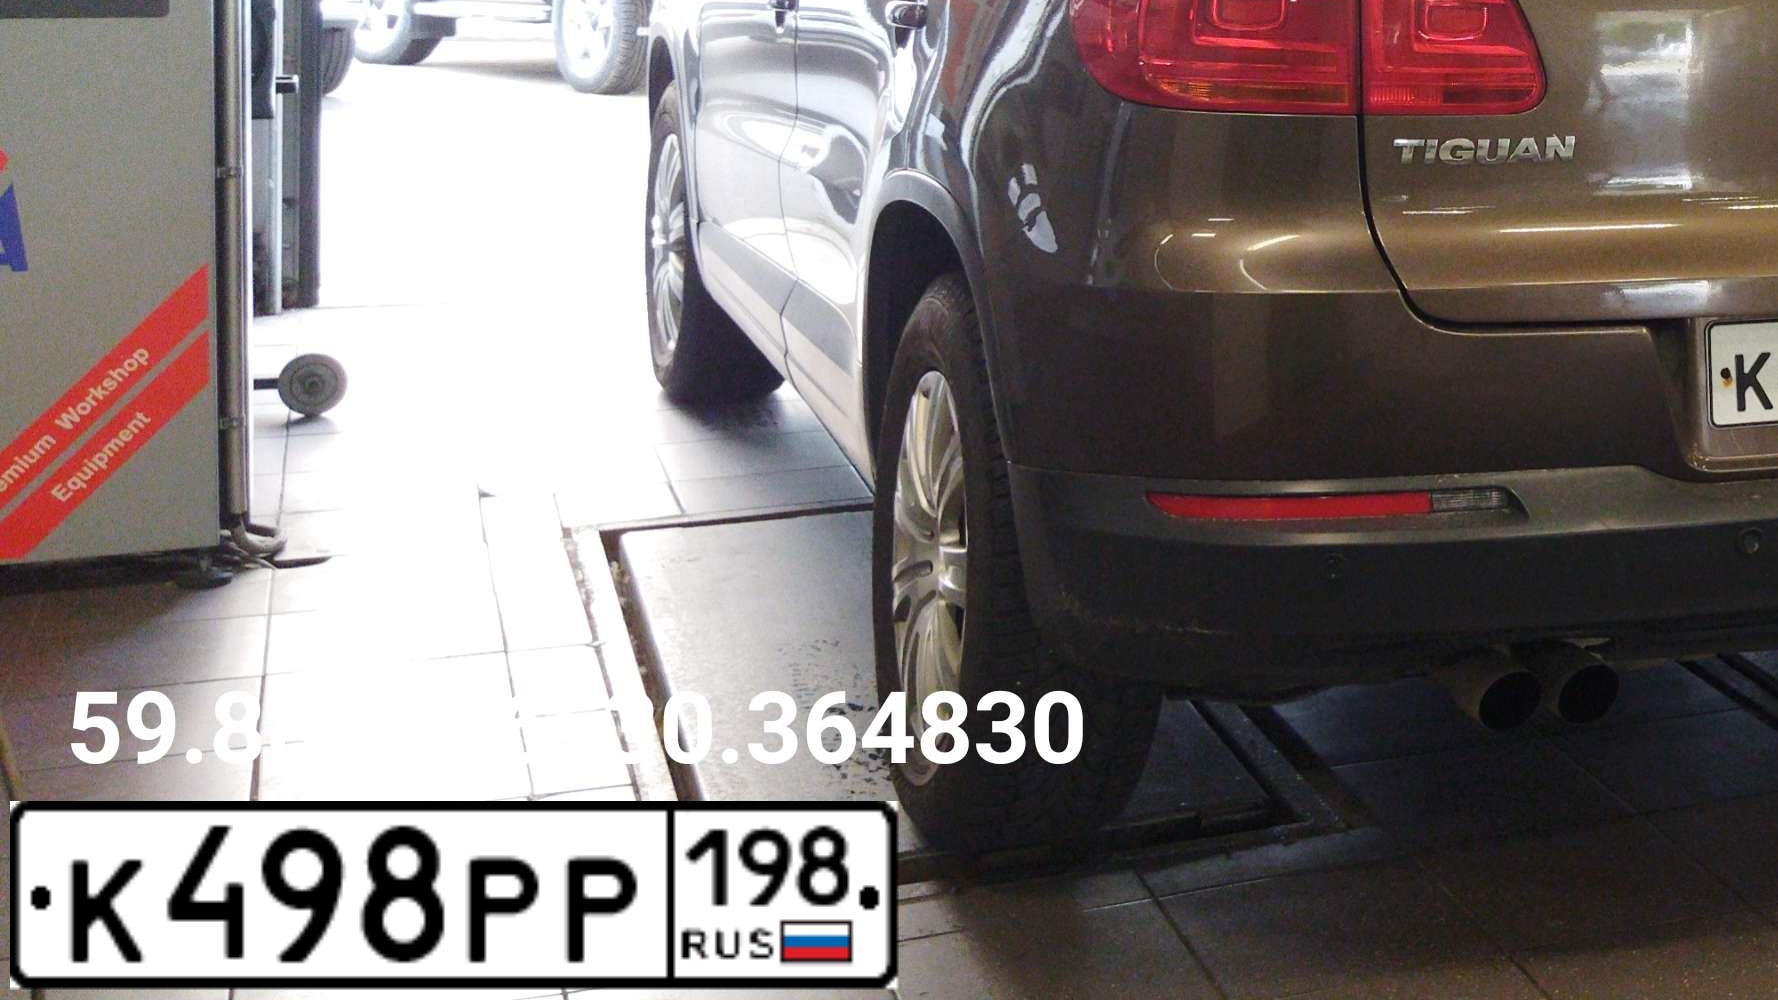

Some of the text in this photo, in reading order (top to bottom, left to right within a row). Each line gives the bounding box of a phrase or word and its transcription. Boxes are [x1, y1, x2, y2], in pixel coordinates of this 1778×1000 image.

[1393, 135, 1576, 165] TIGUAN
[55, 348, 149, 430] Workshop
[51, 411, 151, 502] Equipment
